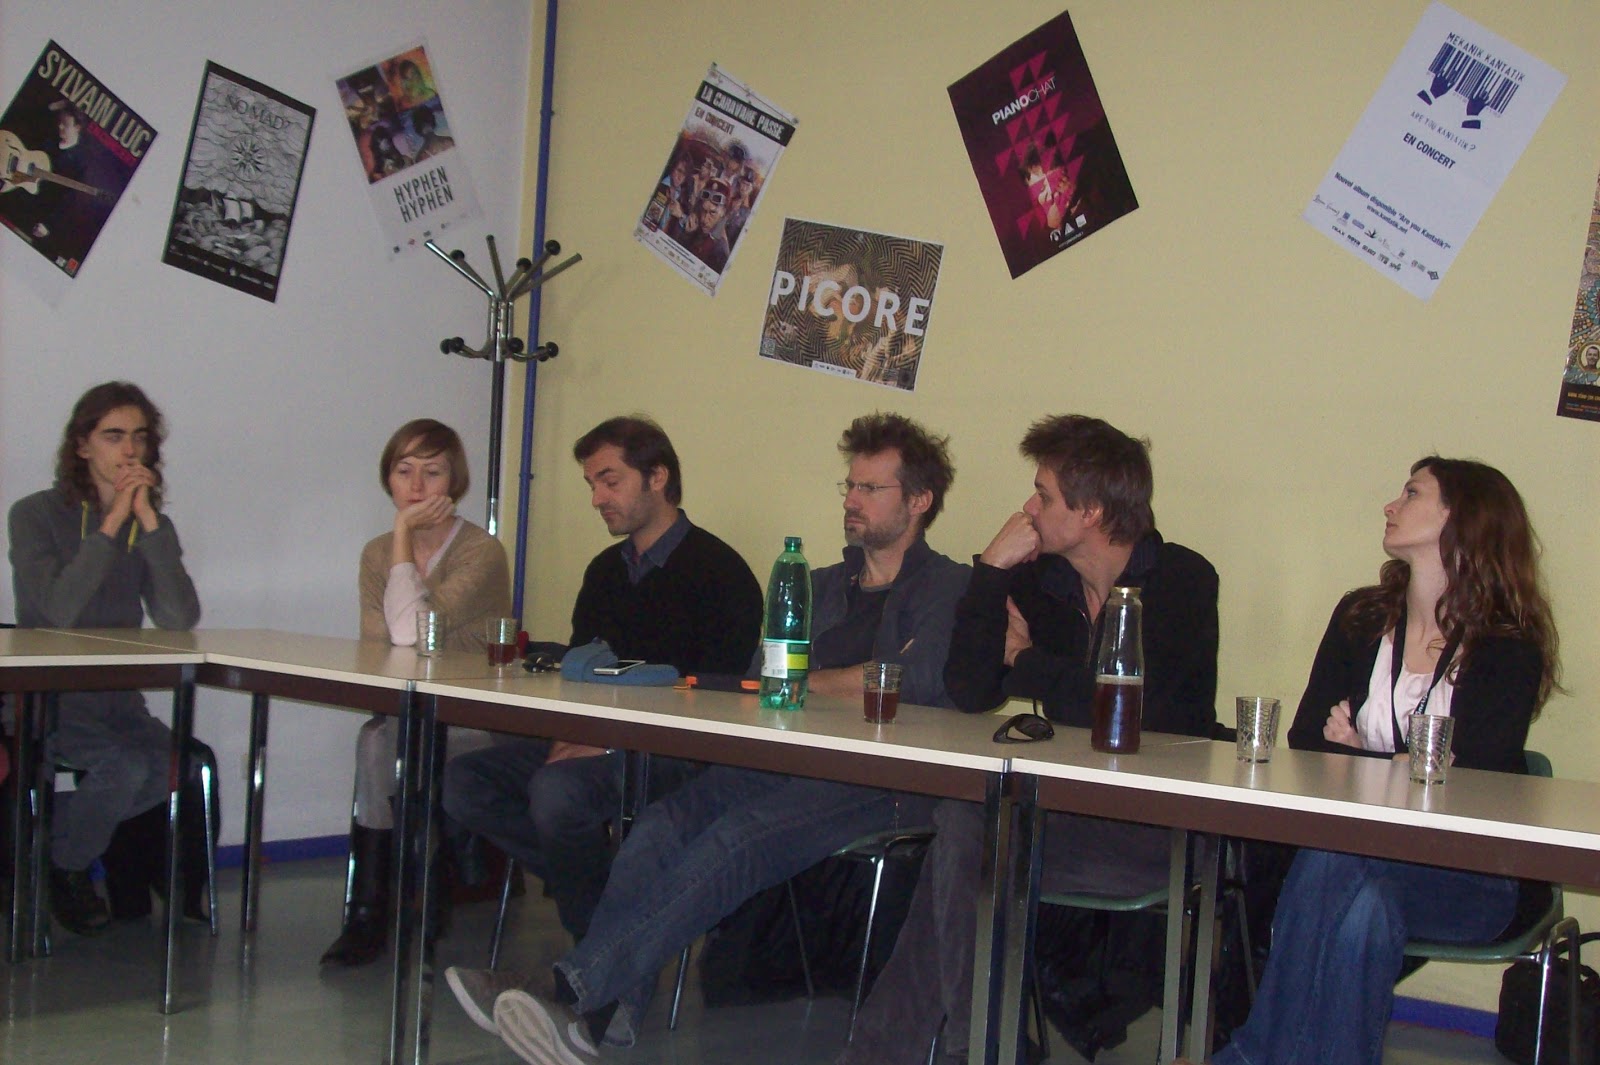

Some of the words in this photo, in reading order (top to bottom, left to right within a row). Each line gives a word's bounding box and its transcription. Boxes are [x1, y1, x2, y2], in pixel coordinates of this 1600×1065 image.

[1447, 32, 1484, 58] MEKANIK
[1485, 53, 1526, 82] KANTATIK
[38, 50, 120, 134] SYLVAIN
[110, 110, 150, 158] LUC
[701, 84, 714, 101] LA
[714, 91, 758, 125] CARAVANE
[757, 111, 785, 141] PASSE
[991, 76, 1057, 125] PIANOCHAT
[1403, 132, 1416, 146] EN
[1416, 141, 1456, 169] CONCERT
[393, 165, 448, 205] HYPHEN
[400, 185, 453, 223] HYPHEN
[1335, 172, 1353, 188] Nouvel
[1353, 185, 1370, 199] album
[1370, 196, 1397, 217] disponible
[770, 270, 930, 336] PICORE
